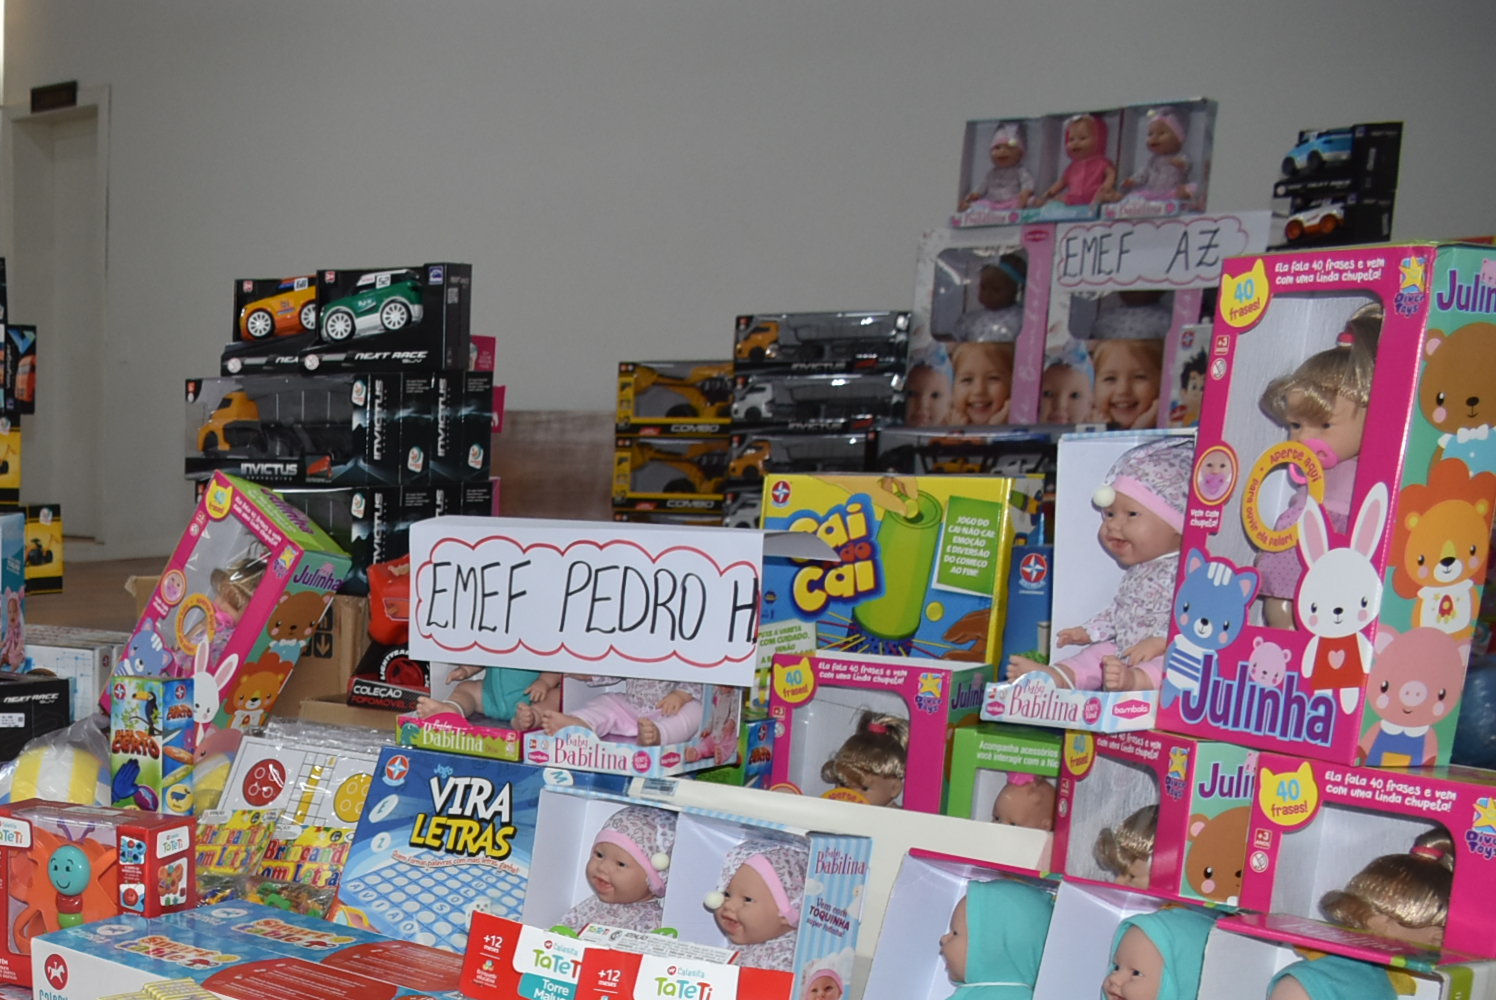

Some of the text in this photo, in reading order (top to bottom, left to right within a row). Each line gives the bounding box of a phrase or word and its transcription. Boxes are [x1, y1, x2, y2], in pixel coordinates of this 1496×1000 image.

[1064, 230, 1134, 277] EMEF
[1275, 262, 1289, 273] Ela
[1290, 262, 1310, 274] fala
[1312, 260, 1323, 271] 40
[1326, 259, 1354, 273] frases
[1367, 258, 1385, 269] vem
[1276, 269, 1381, 285] com uma chupeta!
[1234, 279, 1254, 303] 40
[354, 351, 429, 362] NEXT RACE
[373, 379, 385, 461] INVICTUS
[437, 378, 448, 457] INVICTUS
[670, 423, 720, 433] COMBO
[666, 498, 715, 509] COMBO
[292, 564, 344, 593] Julinha
[793, 560, 875, 612] Cai
[426, 559, 532, 635] EMEF
[559, 560, 707, 642] PEDRO
[784, 669, 802, 686] 40
[1024, 675, 1046, 694] Baby
[353, 685, 403, 699] COLEÇÃO
[1008, 685, 1079, 722] Babilina
[1181, 653, 1336, 746] Julinha
[1113, 703, 1151, 717] bambola
[421, 722, 485, 754] Babilina
[554, 737, 628, 772] Babilina
[432, 762, 454, 777] Jogo
[1276, 778, 1302, 803] 40
[1325, 770, 1342, 782] Ela
[1344, 773, 1367, 787] fala
[1370, 777, 1383, 790] 40
[1385, 779, 1421, 796] frases
[1435, 790, 1457, 802] vem
[1325, 784, 1452, 813] com uma chupeta!
[430, 777, 513, 824] VIRA
[1271, 800, 1309, 819] frases!
[411, 814, 516, 858] LETRAS
[1257, 831, 1270, 842] +3
[814, 850, 868, 876] Babilina
[808, 905, 851, 932] TOQUINHA
[482, 933, 504, 950] +12
[540, 979, 571, 997] Torre
[598, 968, 622, 983] +12
